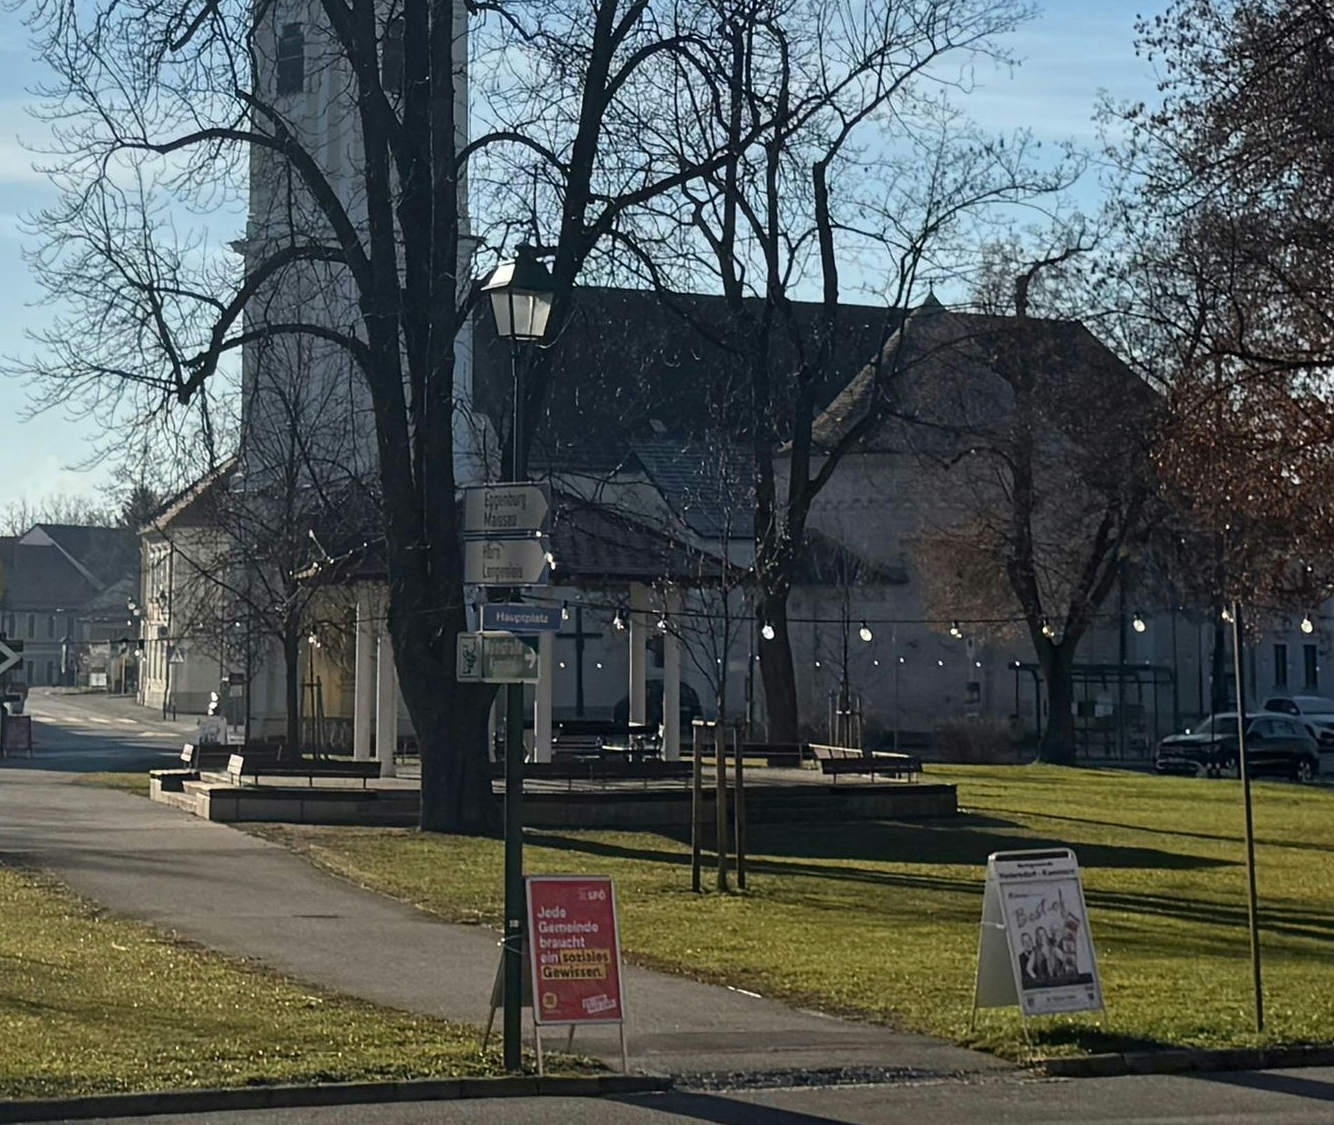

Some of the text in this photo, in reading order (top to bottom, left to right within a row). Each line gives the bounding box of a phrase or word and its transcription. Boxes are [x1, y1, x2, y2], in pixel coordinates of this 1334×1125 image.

[495, 611, 549, 624] Hauptplatz
[537, 906, 567, 919] Jede
[538, 921, 599, 933] Gemeinde
[539, 936, 585, 948] braucht
[540, 949, 609, 964] ein soziales
